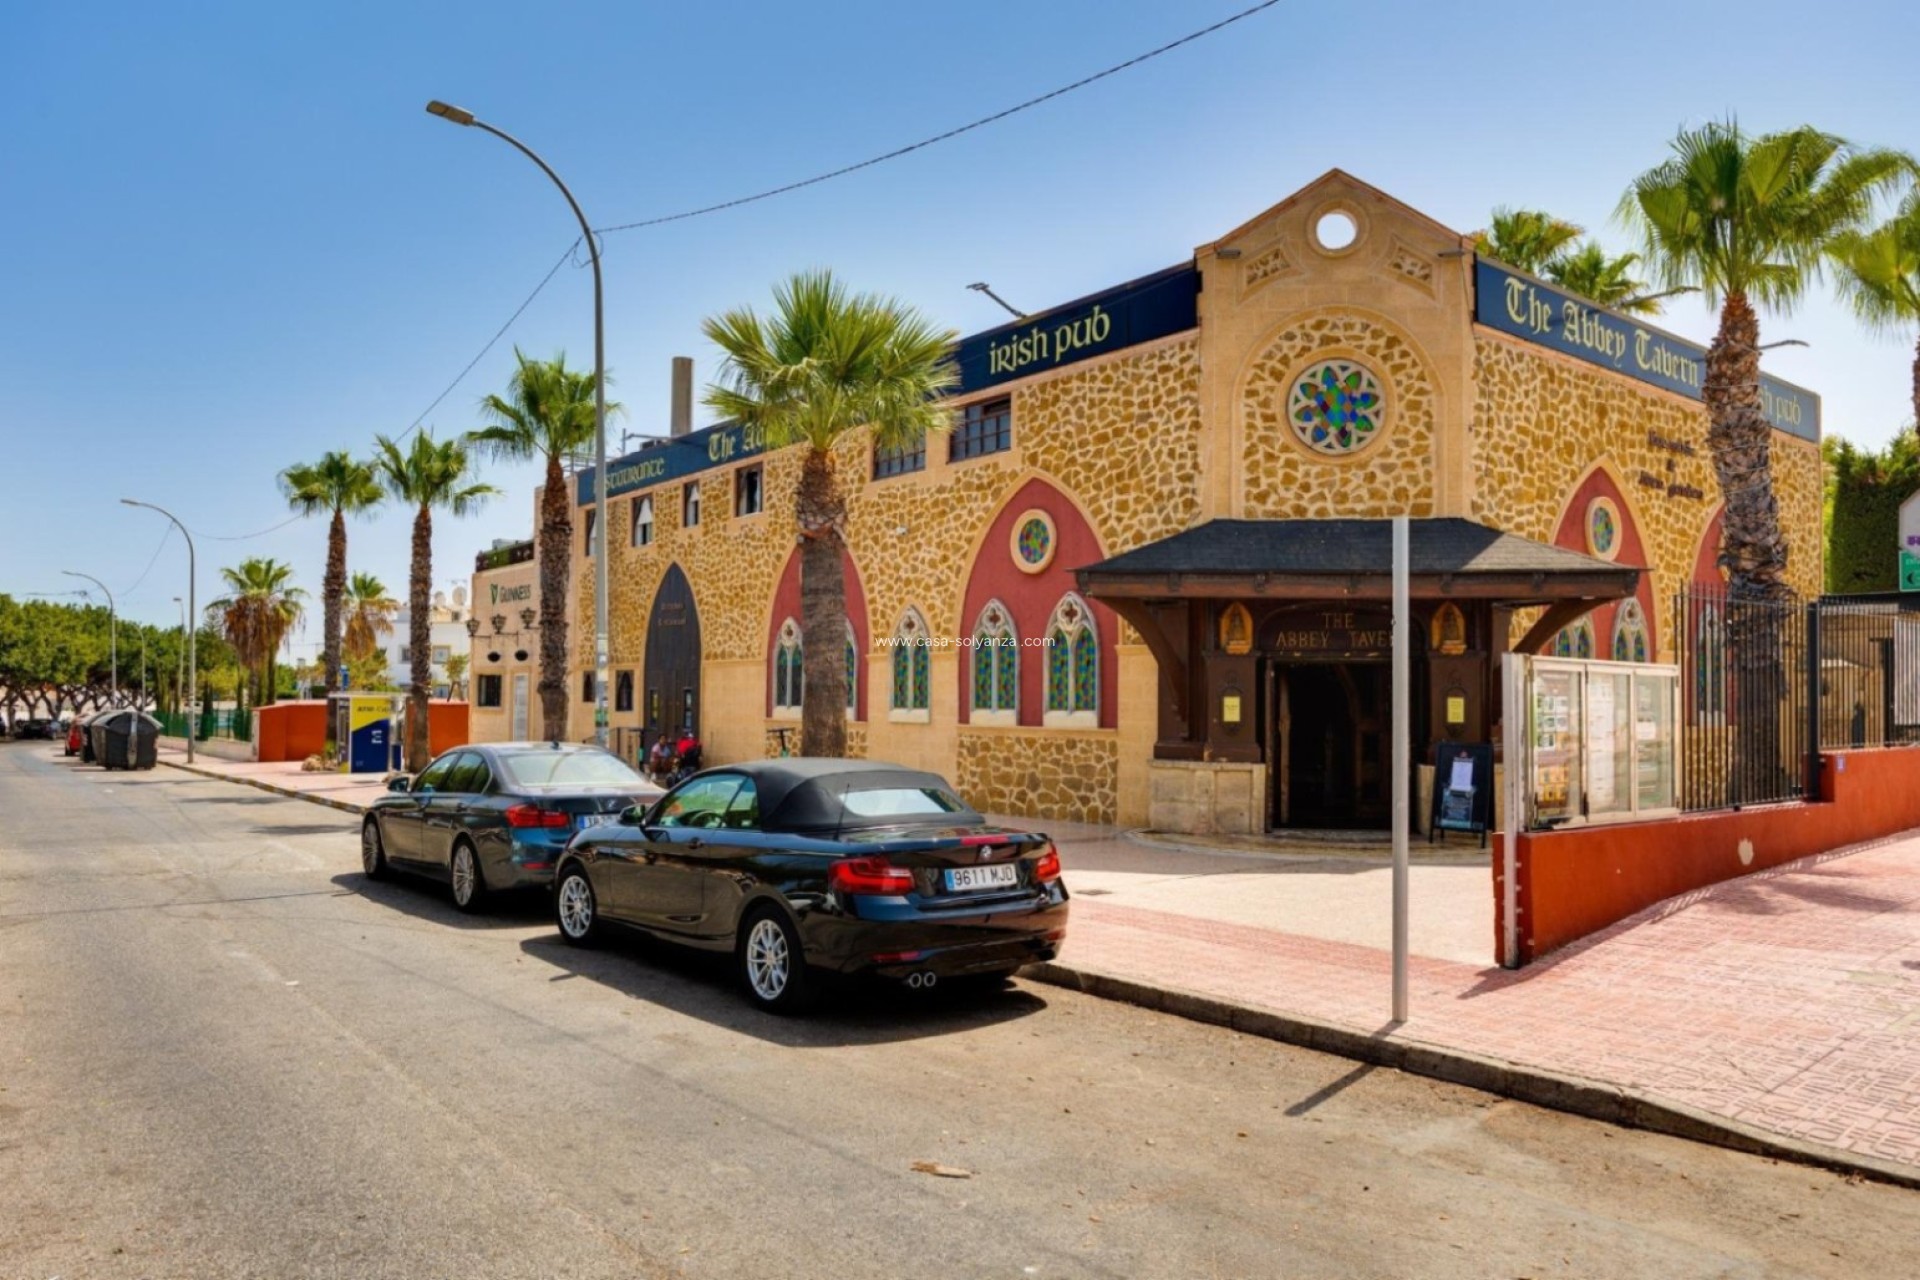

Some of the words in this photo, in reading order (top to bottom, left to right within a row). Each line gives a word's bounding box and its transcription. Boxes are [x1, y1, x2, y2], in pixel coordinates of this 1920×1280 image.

[1055, 304, 1111, 363] pub
[1503, 275, 1553, 334] The
[1562, 299, 1626, 368] Abbey
[1633, 327, 1699, 389] Tavern
[1776, 394, 1801, 426] pub
[708, 430, 737, 462] The
[1321, 612, 1355, 629] THE
[1276, 629, 1330, 648] ABBEY
[1347, 629, 1392, 648] TAVE
[954, 869, 987, 886] 9611
